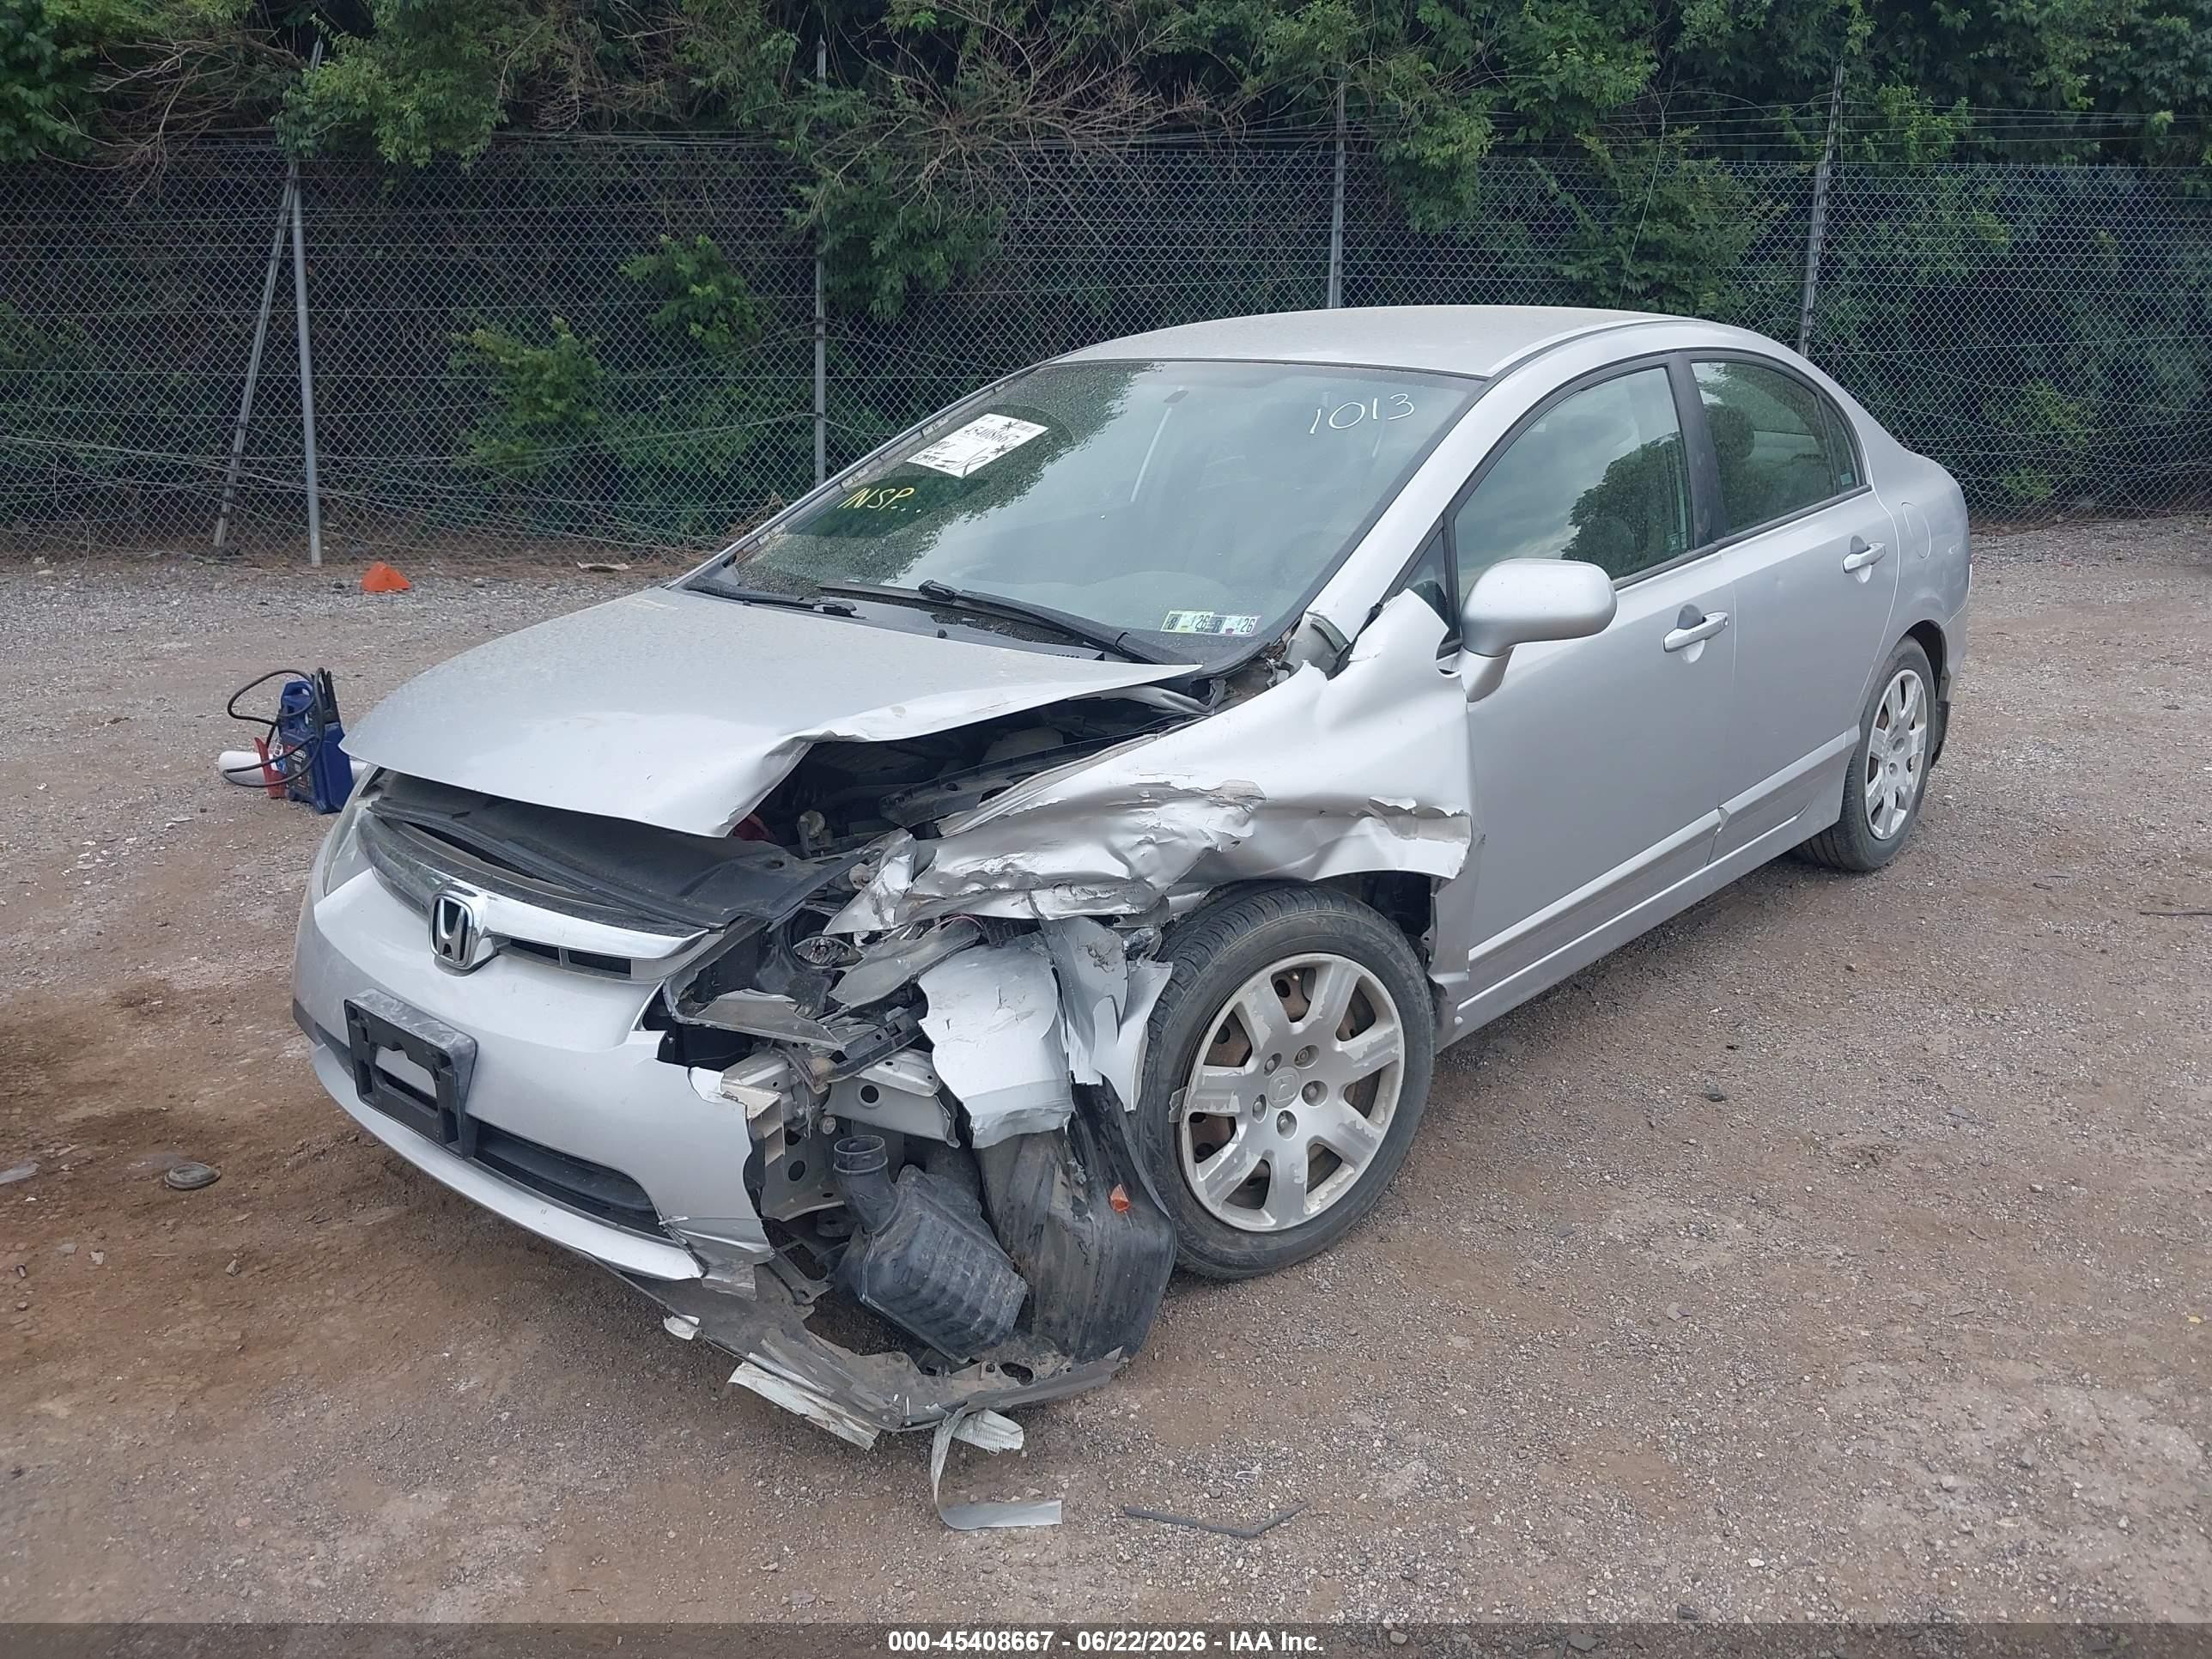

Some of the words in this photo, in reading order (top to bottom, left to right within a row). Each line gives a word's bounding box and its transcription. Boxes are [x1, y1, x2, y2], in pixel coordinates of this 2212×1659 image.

[1309, 392, 1416, 434] 1013
[1194, 614, 1211, 629] 26
[1240, 617, 1256, 633] 26
